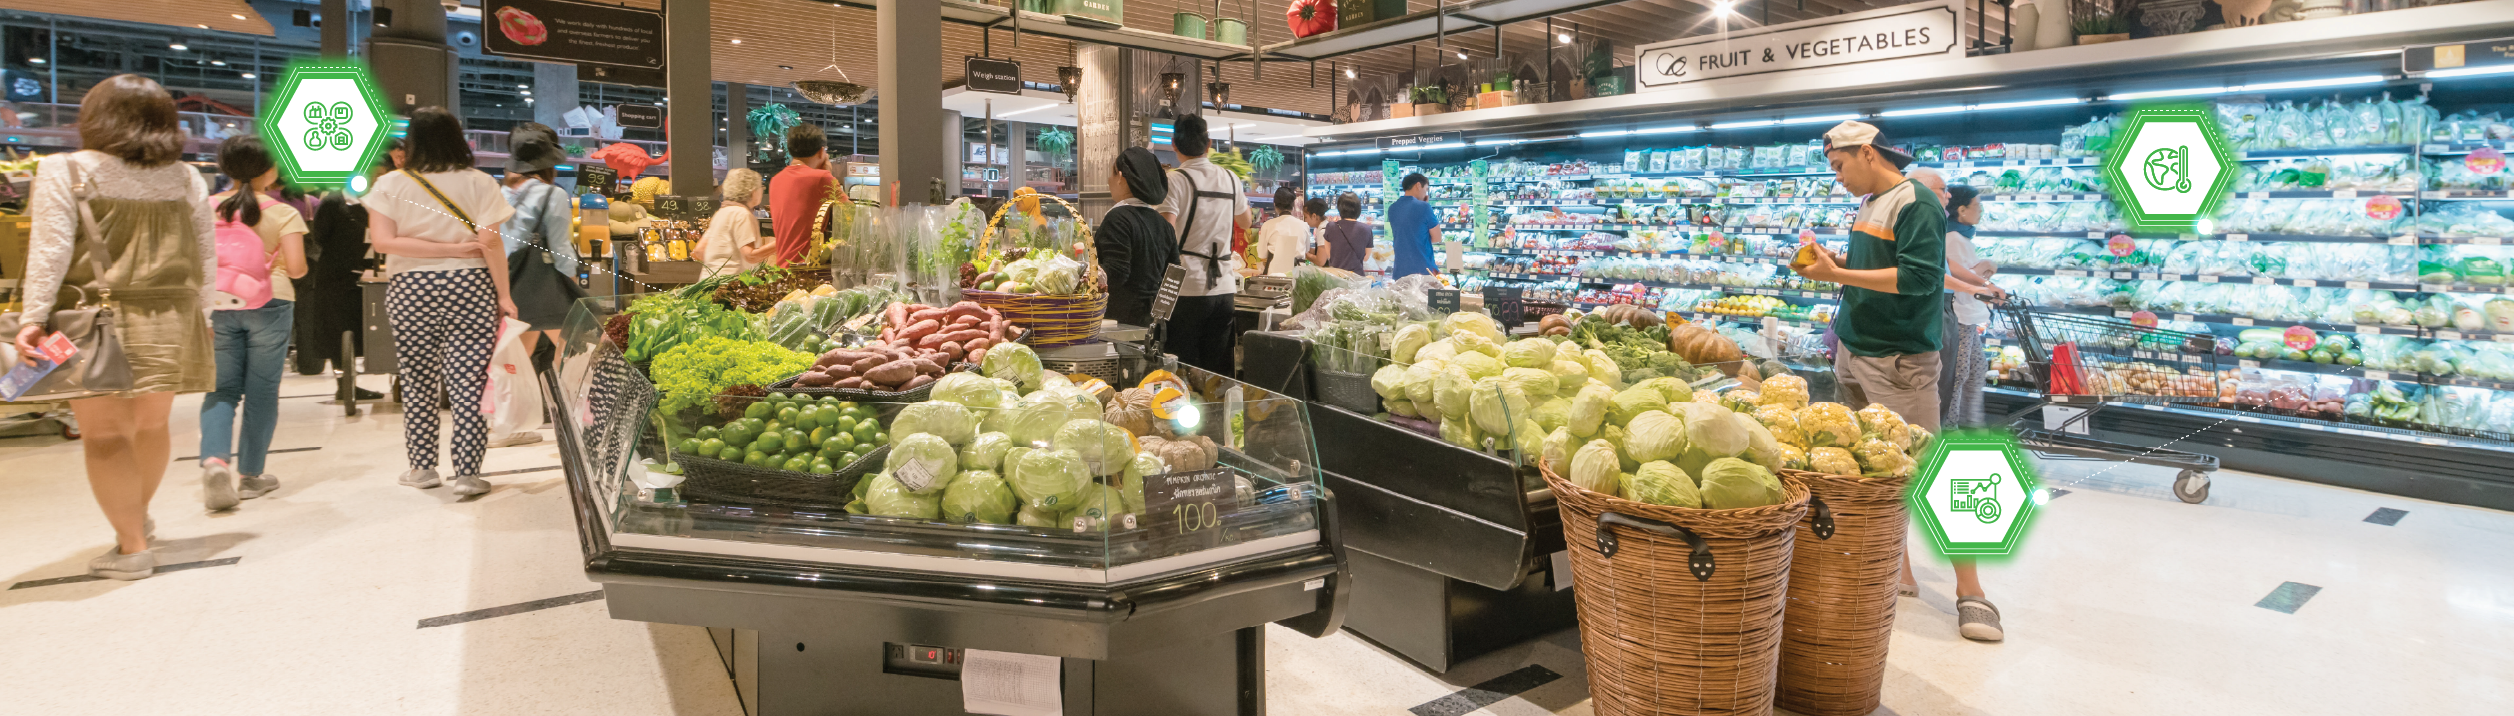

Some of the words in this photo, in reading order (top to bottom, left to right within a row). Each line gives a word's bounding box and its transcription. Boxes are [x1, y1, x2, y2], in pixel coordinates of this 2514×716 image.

[1083, 0, 1110, 11] GARDEN
[582, 21, 595, 29] daily
[608, 24, 633, 32] hundreds
[1699, 50, 1752, 71] FRUIT
[1762, 47, 1775, 63] &
[1785, 27, 1931, 60] VEGETABLES
[972, 70, 994, 81] Weigh
[994, 74, 1016, 82] station
[621, 112, 646, 120] Shopping
[1391, 136, 1417, 146] Prepped
[1418, 134, 1443, 144] Veggies
